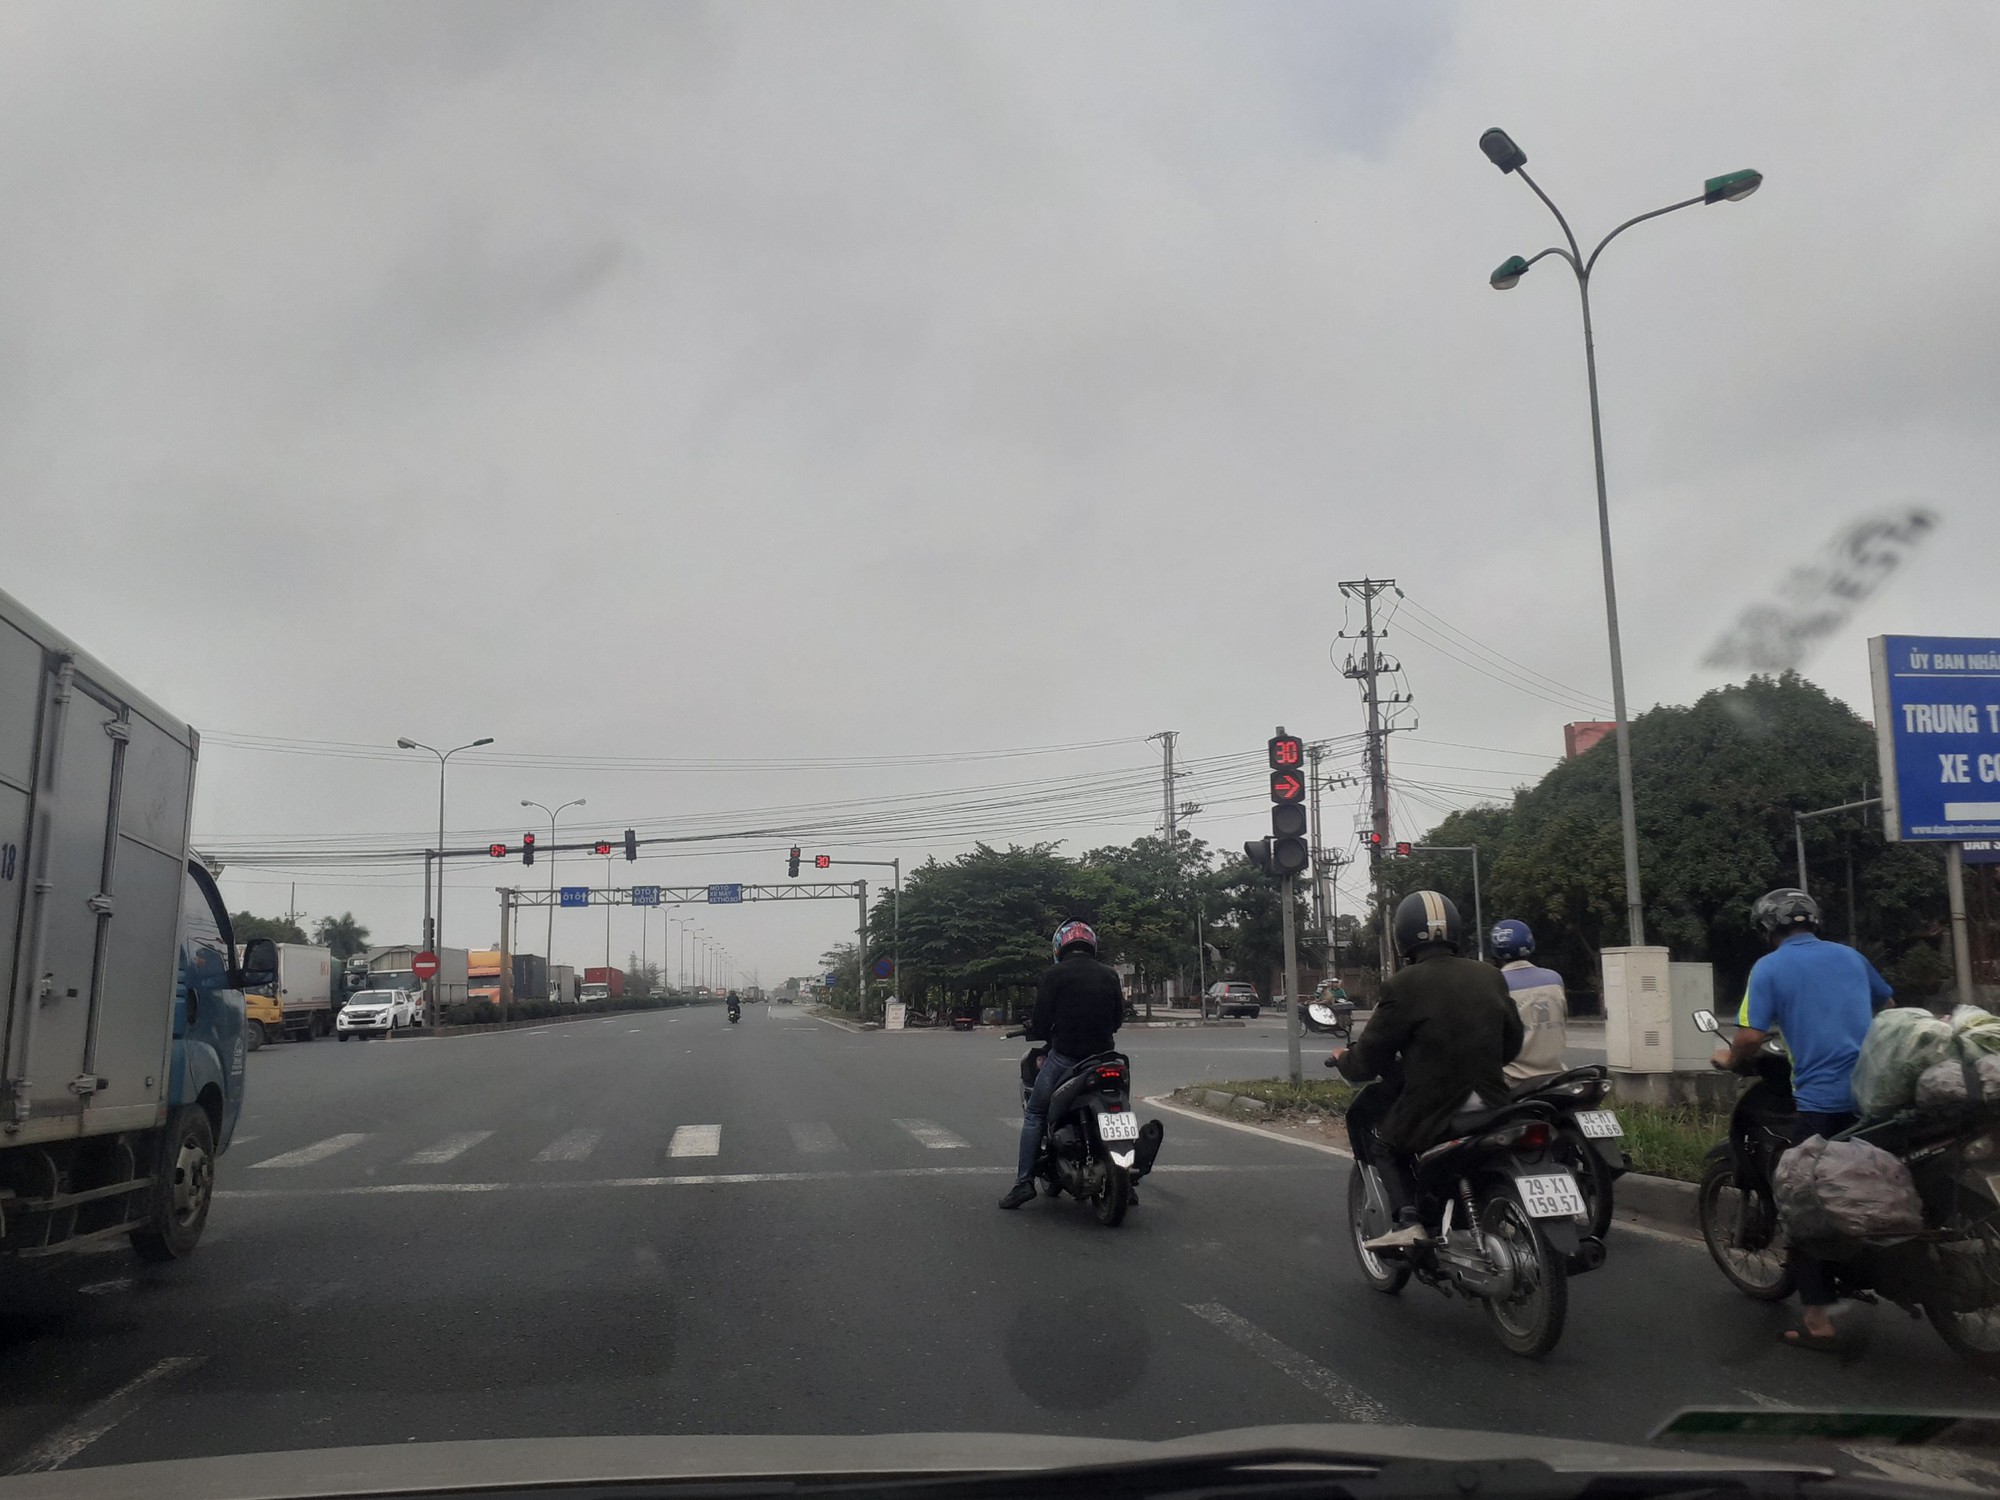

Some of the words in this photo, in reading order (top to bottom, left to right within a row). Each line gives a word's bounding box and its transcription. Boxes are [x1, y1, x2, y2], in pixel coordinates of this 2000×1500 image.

[1910, 647, 1929, 669] ỦY
[1933, 653, 1965, 670] BAN
[1902, 704, 1979, 733] TRUNG
[1276, 741, 1298, 764] 30
[1938, 753, 1971, 783] XE
[817, 856, 828, 867] 30
[1104, 1114, 1131, 1126] 34-L1
[1583, 1123, 1620, 1136] 043.66
[1102, 1126, 1137, 1138] 035.60
[1525, 1177, 1569, 1196] 29-X1
[1529, 1194, 1579, 1214] 159.57
